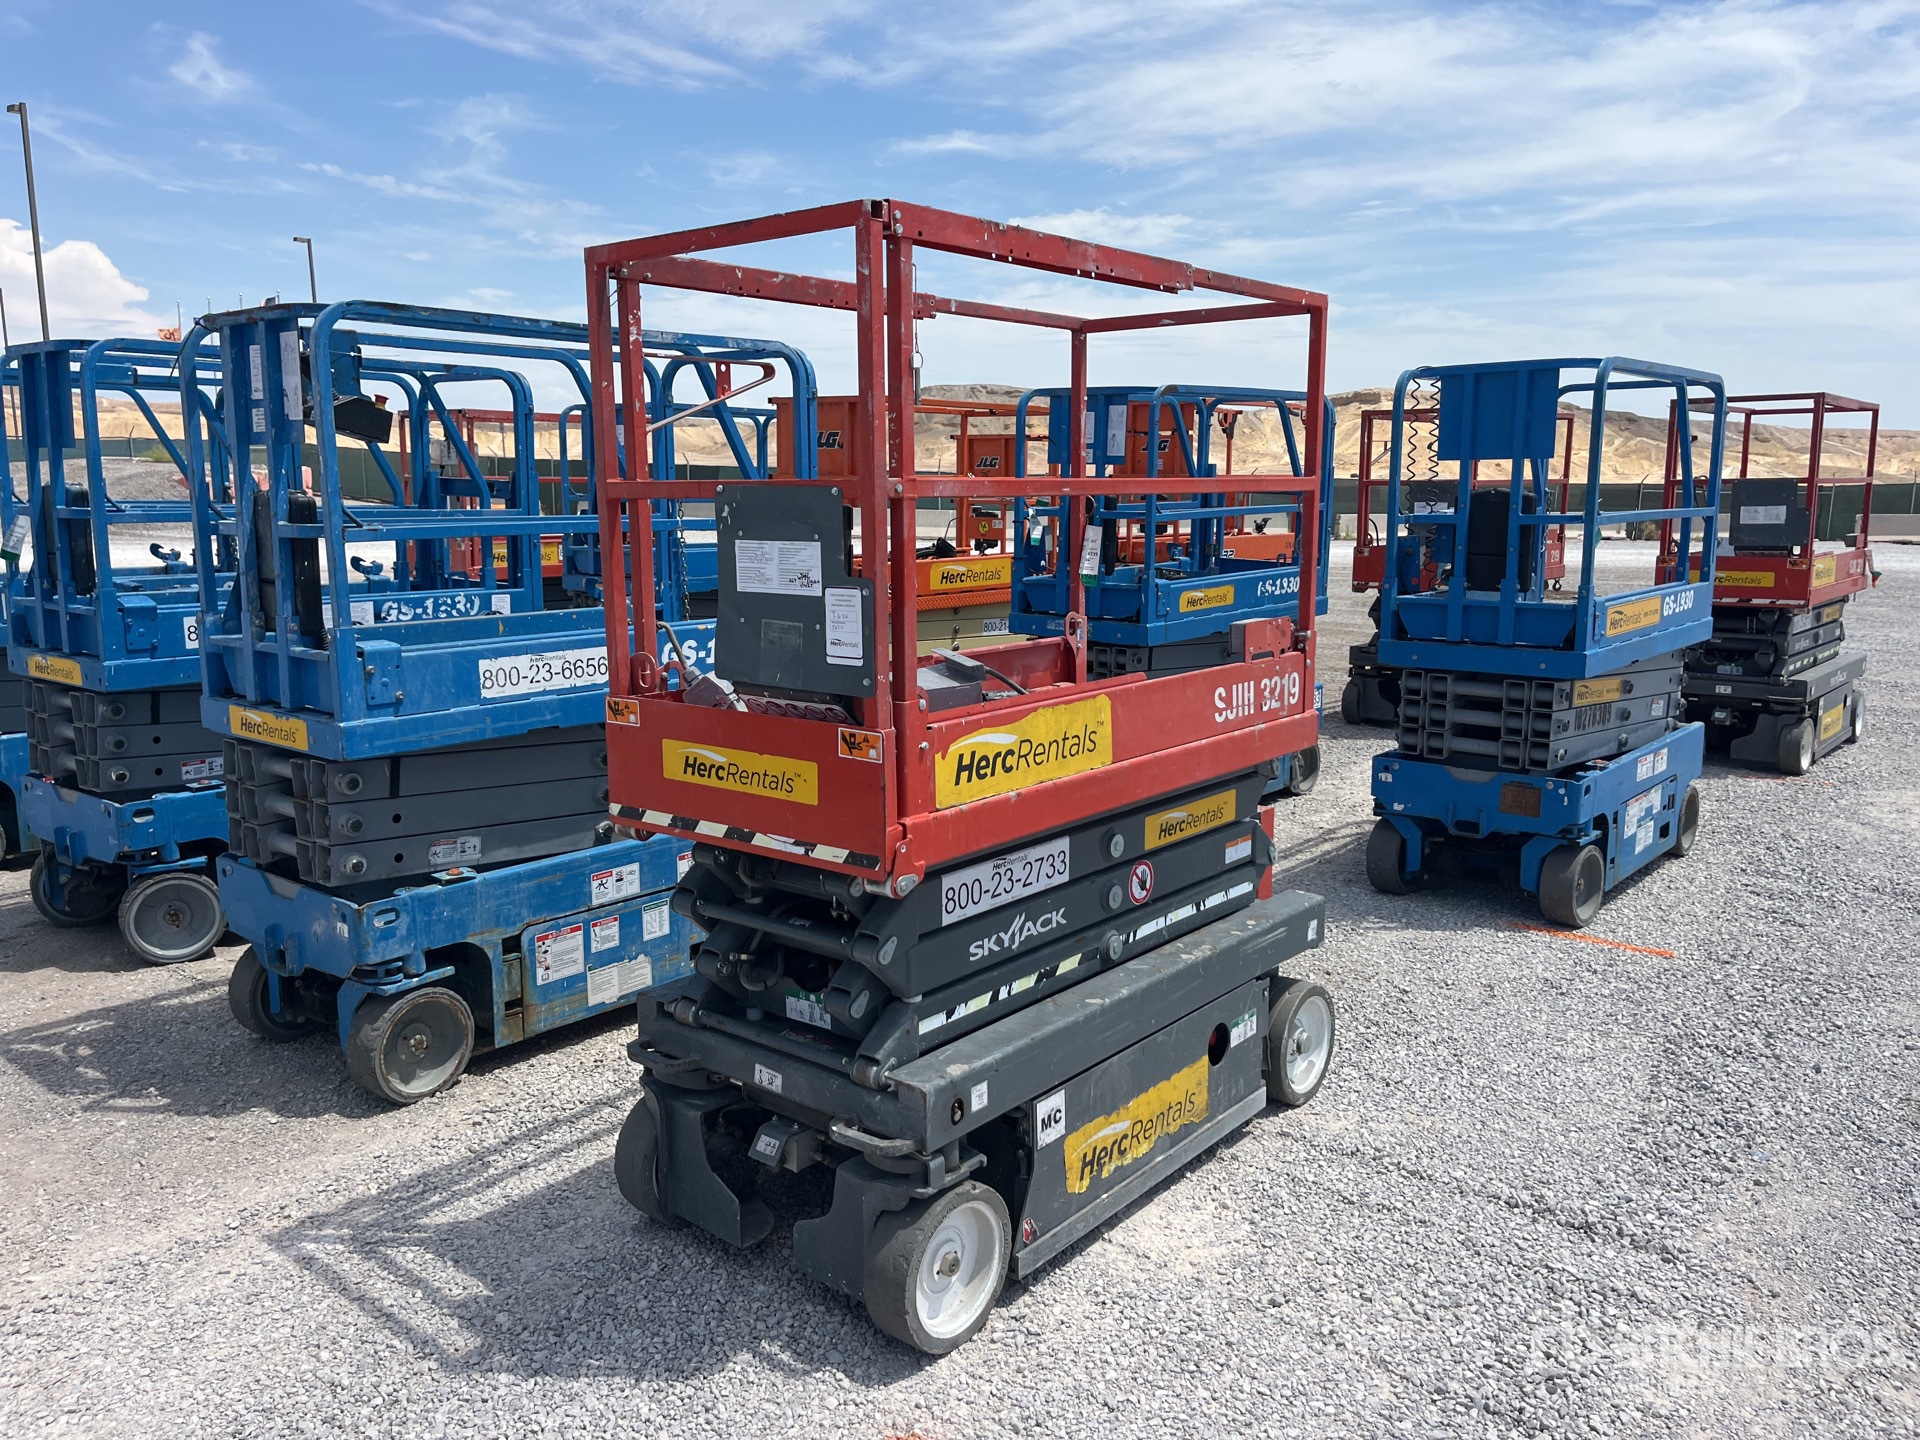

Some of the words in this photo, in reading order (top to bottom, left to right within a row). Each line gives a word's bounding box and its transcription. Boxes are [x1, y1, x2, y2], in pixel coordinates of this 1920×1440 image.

[817, 431, 842, 449] LG
[976, 456, 999, 468] JLG
[1714, 574, 1763, 585] rcRentals
[1663, 590, 1694, 616] GS-1930
[983, 621, 1009, 632] 800-21-
[661, 638, 716, 667] GS-1
[482, 655, 609, 690] 800-23-6656
[1260, 672, 1300, 712] 3219
[944, 849, 1067, 916] 800-23-2733
[968, 906, 1068, 961] SKYJACK
[1041, 1109, 1062, 1132] MC
